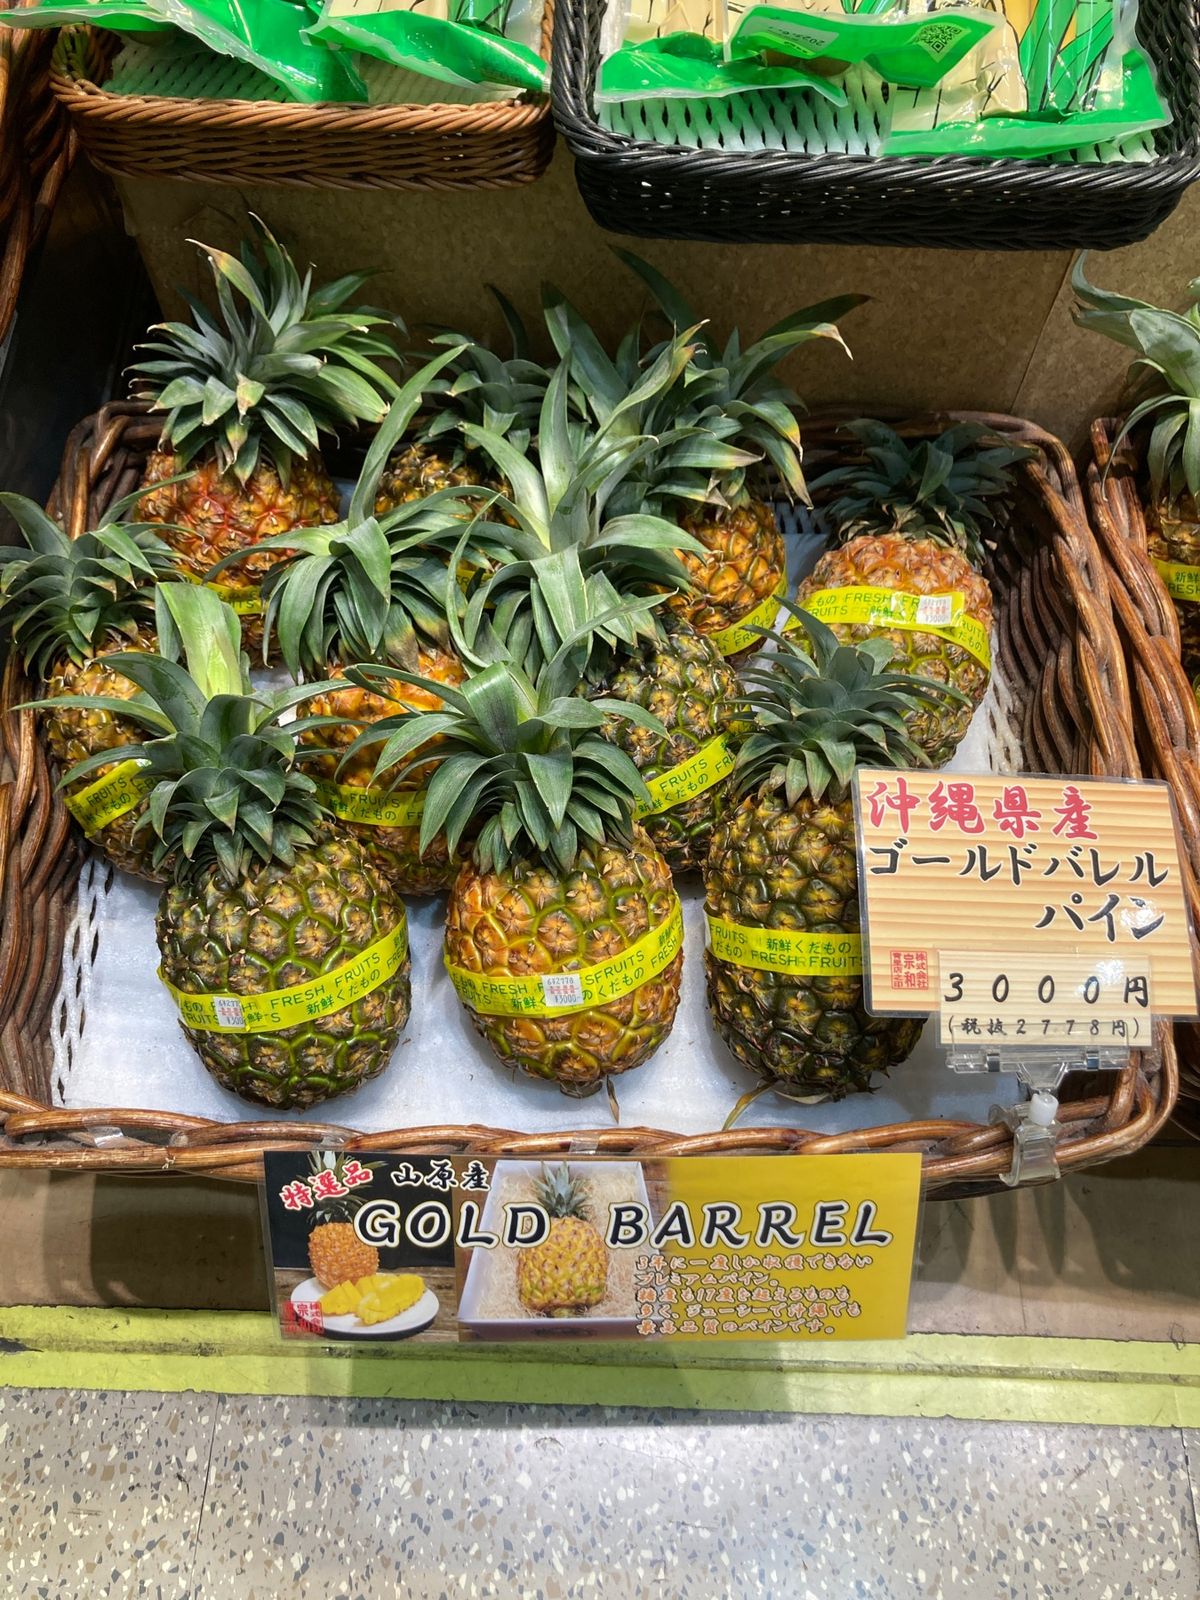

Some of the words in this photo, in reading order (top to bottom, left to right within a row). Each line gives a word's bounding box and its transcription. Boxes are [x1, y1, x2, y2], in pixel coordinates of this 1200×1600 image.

[845, 592, 892, 604] FRESH
[659, 758, 708, 792] FRUITS
[867, 777, 1098, 840] 沖縄県産
[868, 837, 1169, 888] ゴールドバレル
[1034, 893, 1166, 943] パイン
[766, 937, 852, 955] 新鮮くだもの
[270, 984, 326, 1010] FRESH
[334, 952, 382, 988] FRUITS
[305, 968, 382, 1016] 新鮮くだもの
[481, 983, 528, 995] FRESH
[279, 1160, 375, 1210] 特選品
[391, 1159, 491, 1192] 山原産
[354, 1201, 551, 1249] GOLD
[606, 1200, 894, 1249] BARREL
[635, 1318, 835, 1335] 最高品質のパインです。
